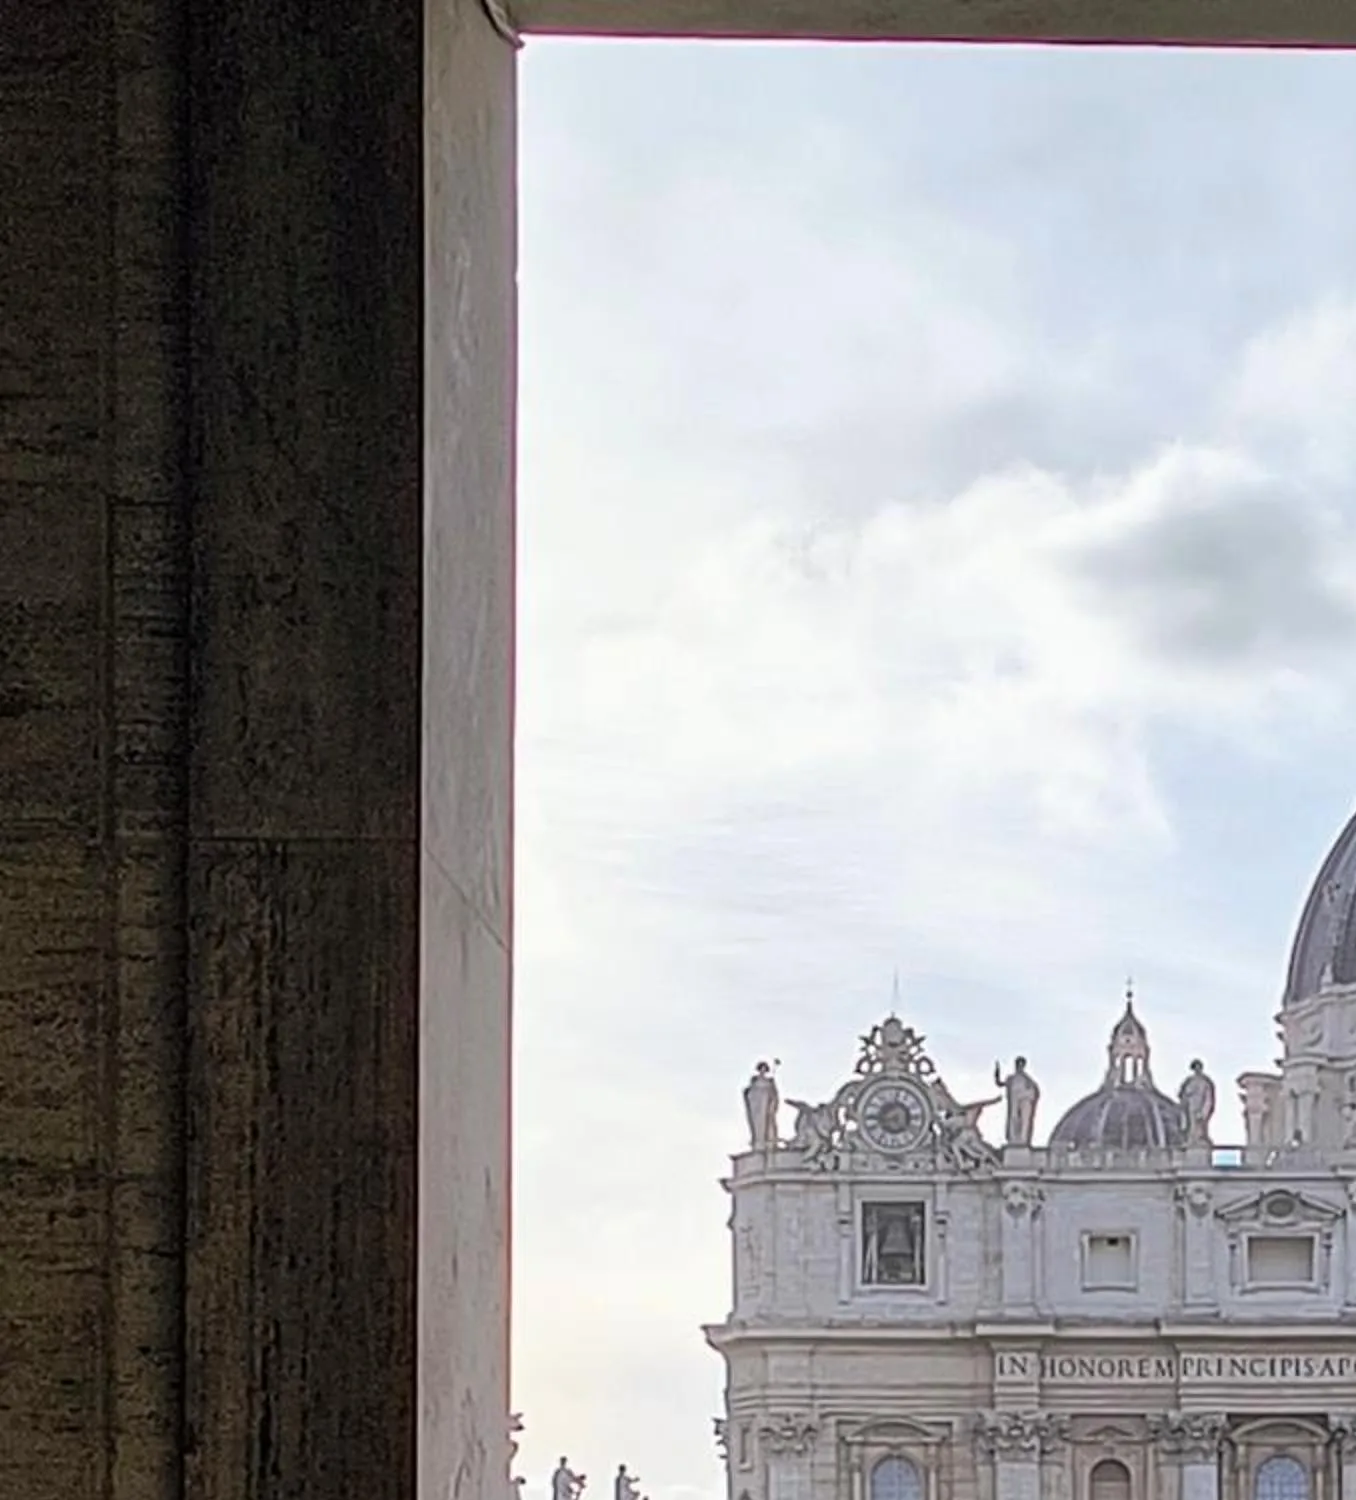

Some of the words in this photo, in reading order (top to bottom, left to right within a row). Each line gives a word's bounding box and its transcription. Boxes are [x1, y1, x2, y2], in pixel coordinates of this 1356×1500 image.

[998, 1355, 1029, 1377] IN
[1039, 1358, 1174, 1379] HONOREM
[1182, 1356, 1315, 1377] PRINCIPIS
